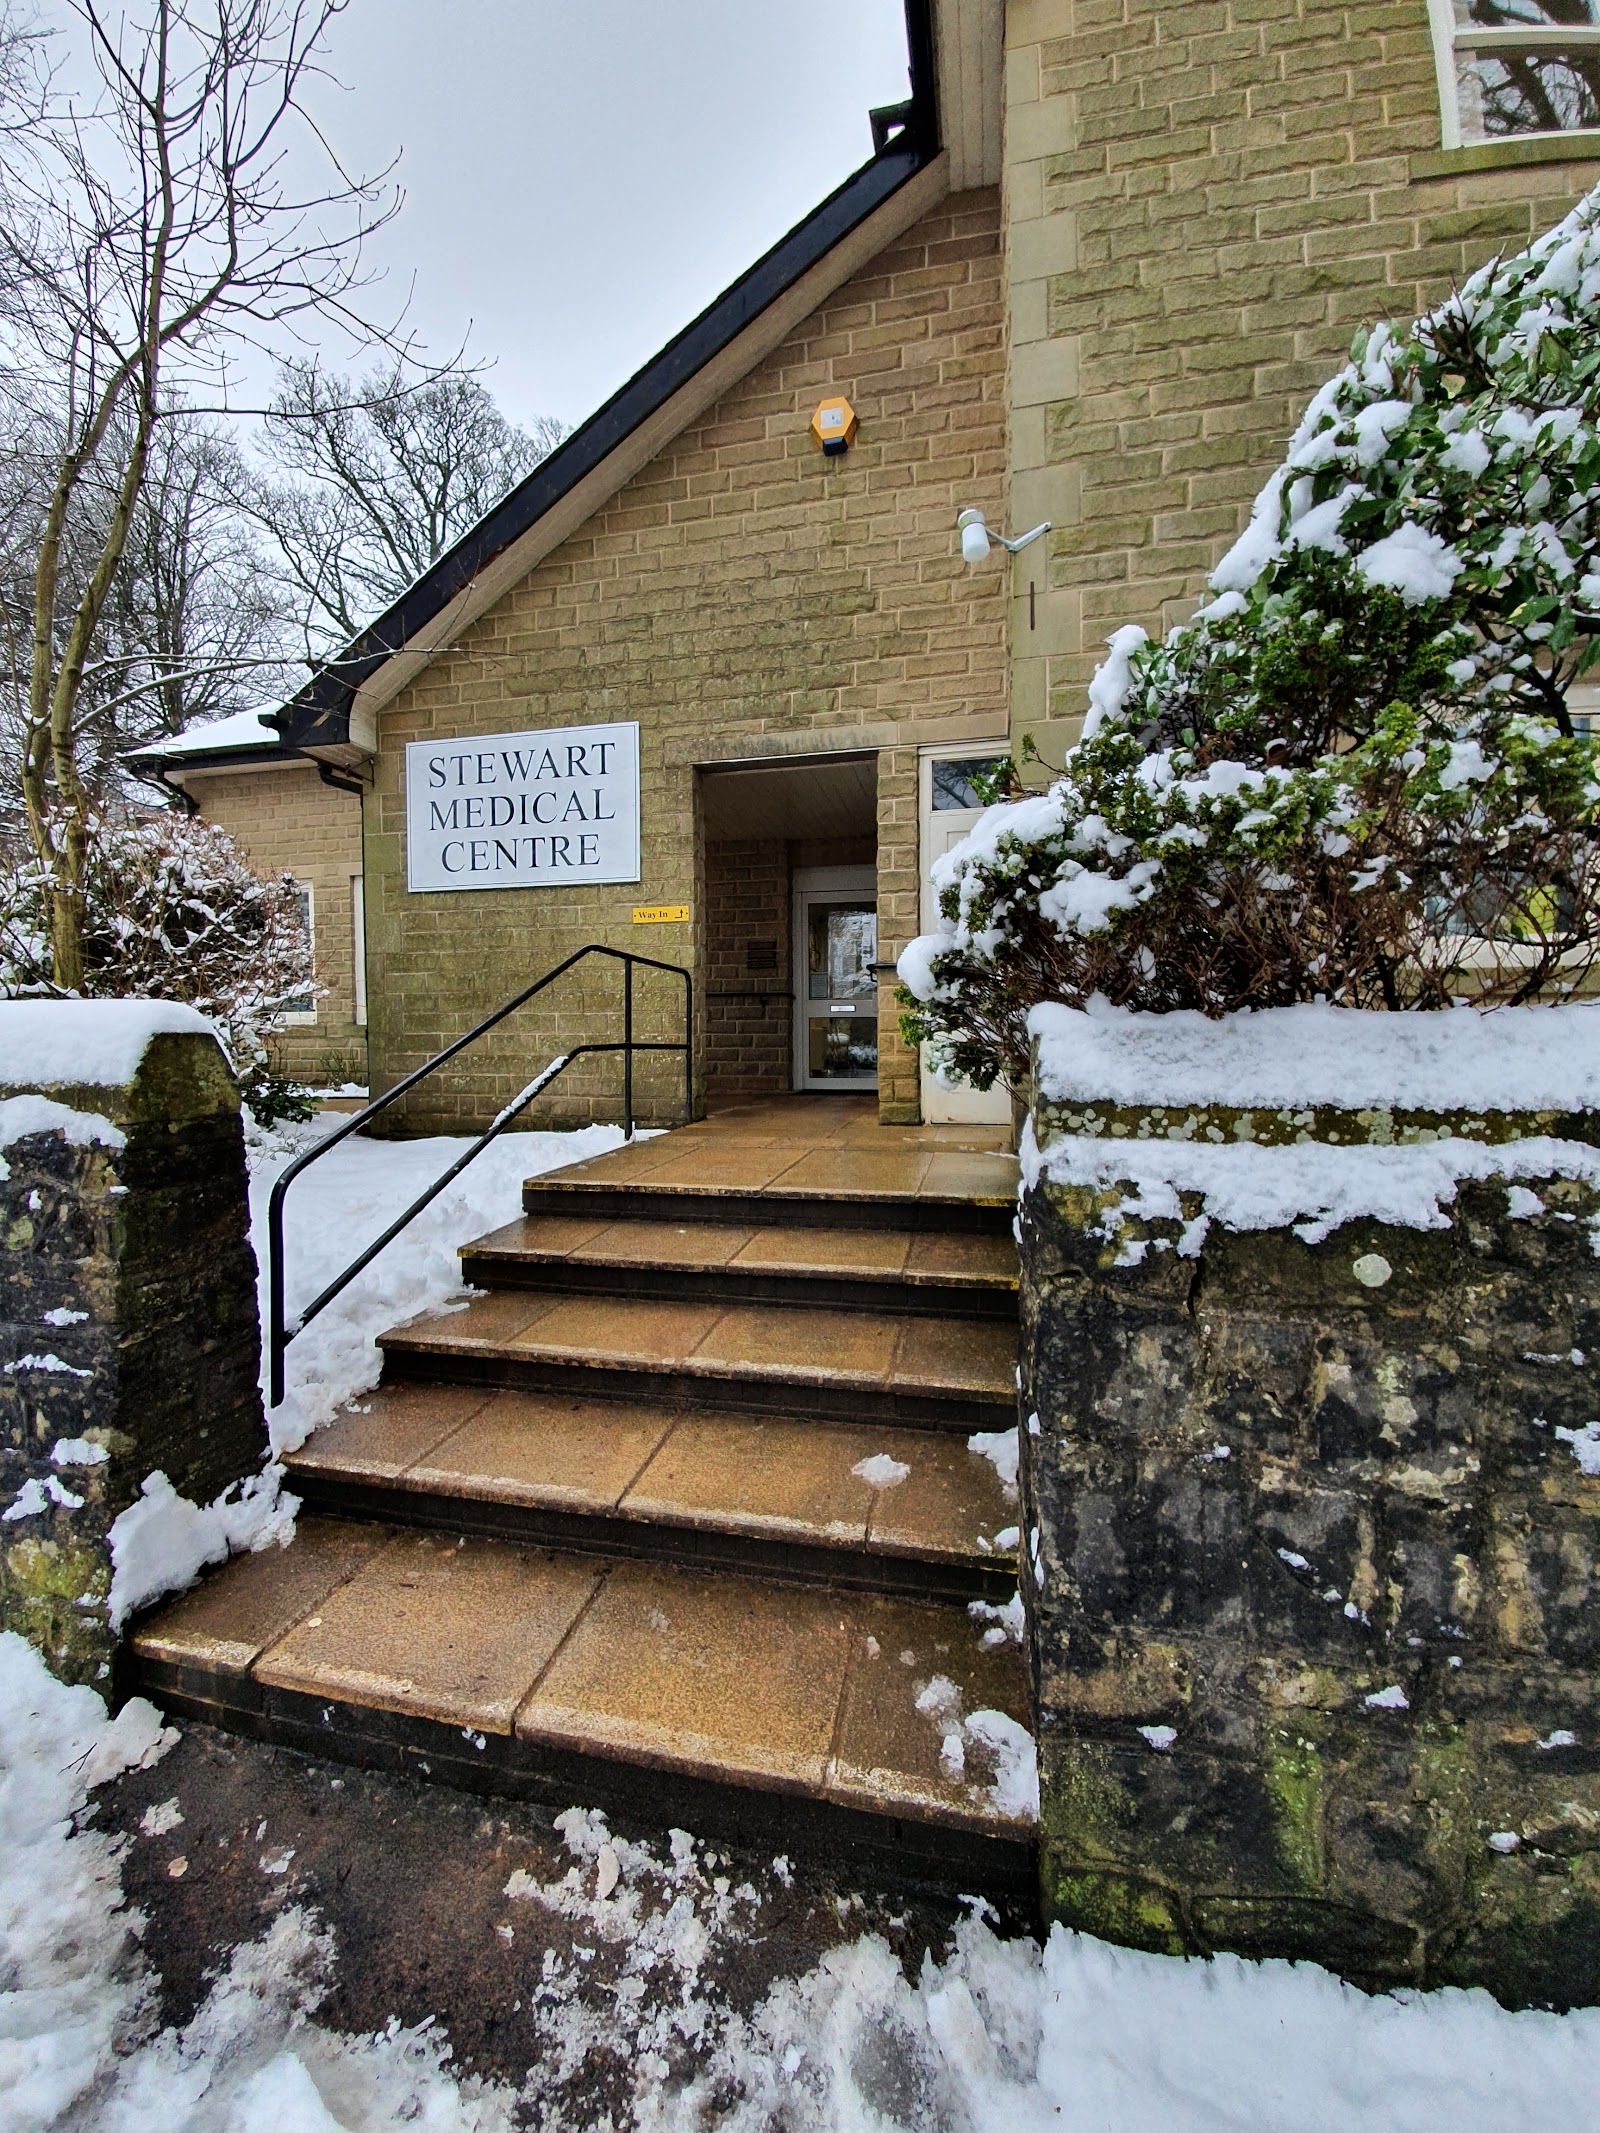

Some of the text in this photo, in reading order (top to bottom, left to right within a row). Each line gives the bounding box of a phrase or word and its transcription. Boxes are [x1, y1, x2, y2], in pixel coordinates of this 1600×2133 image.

[429, 743, 616, 788] STEWART
[430, 789, 616, 831] MEDICAL
[440, 834, 601, 873] CENTRE
[638, 911, 657, 919] Way
